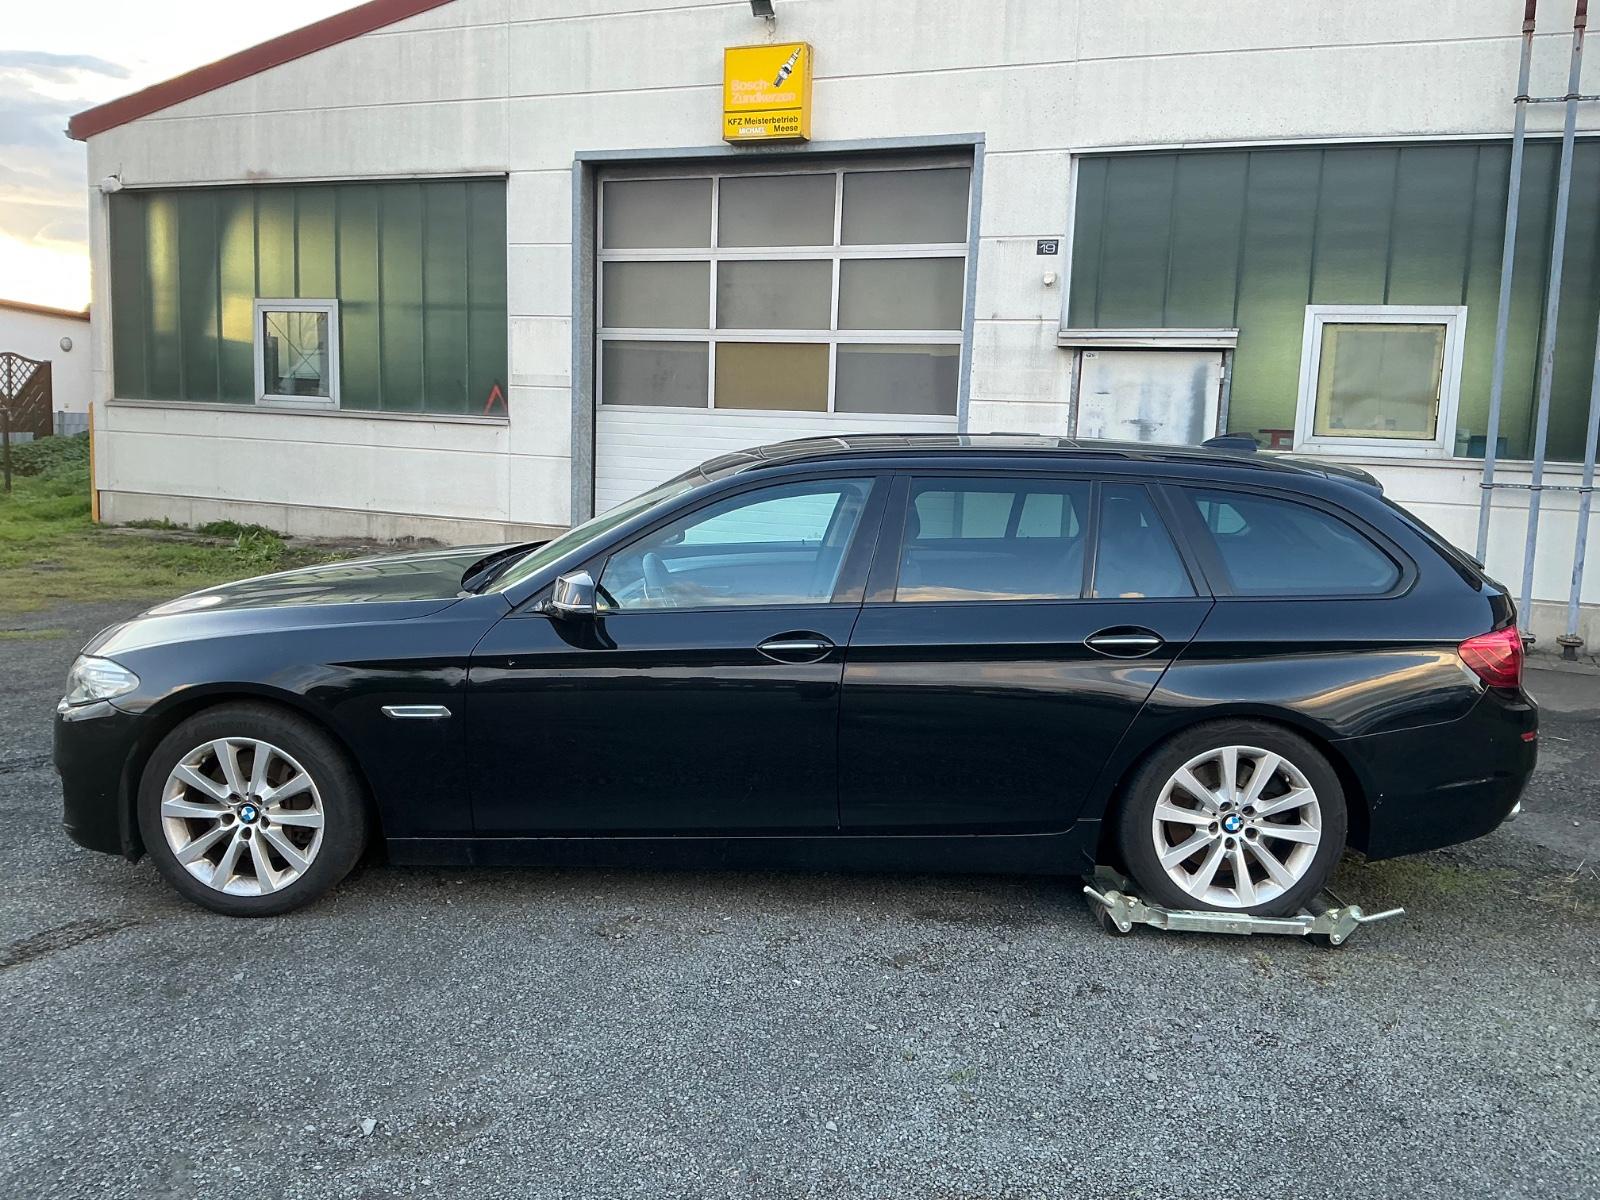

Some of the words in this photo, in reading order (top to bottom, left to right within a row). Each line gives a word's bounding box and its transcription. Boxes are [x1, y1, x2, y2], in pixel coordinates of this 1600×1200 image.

[728, 118, 743, 126] KFZ
[744, 116, 798, 125] Meisterbetrieb
[1040, 244, 1055, 253] 19
